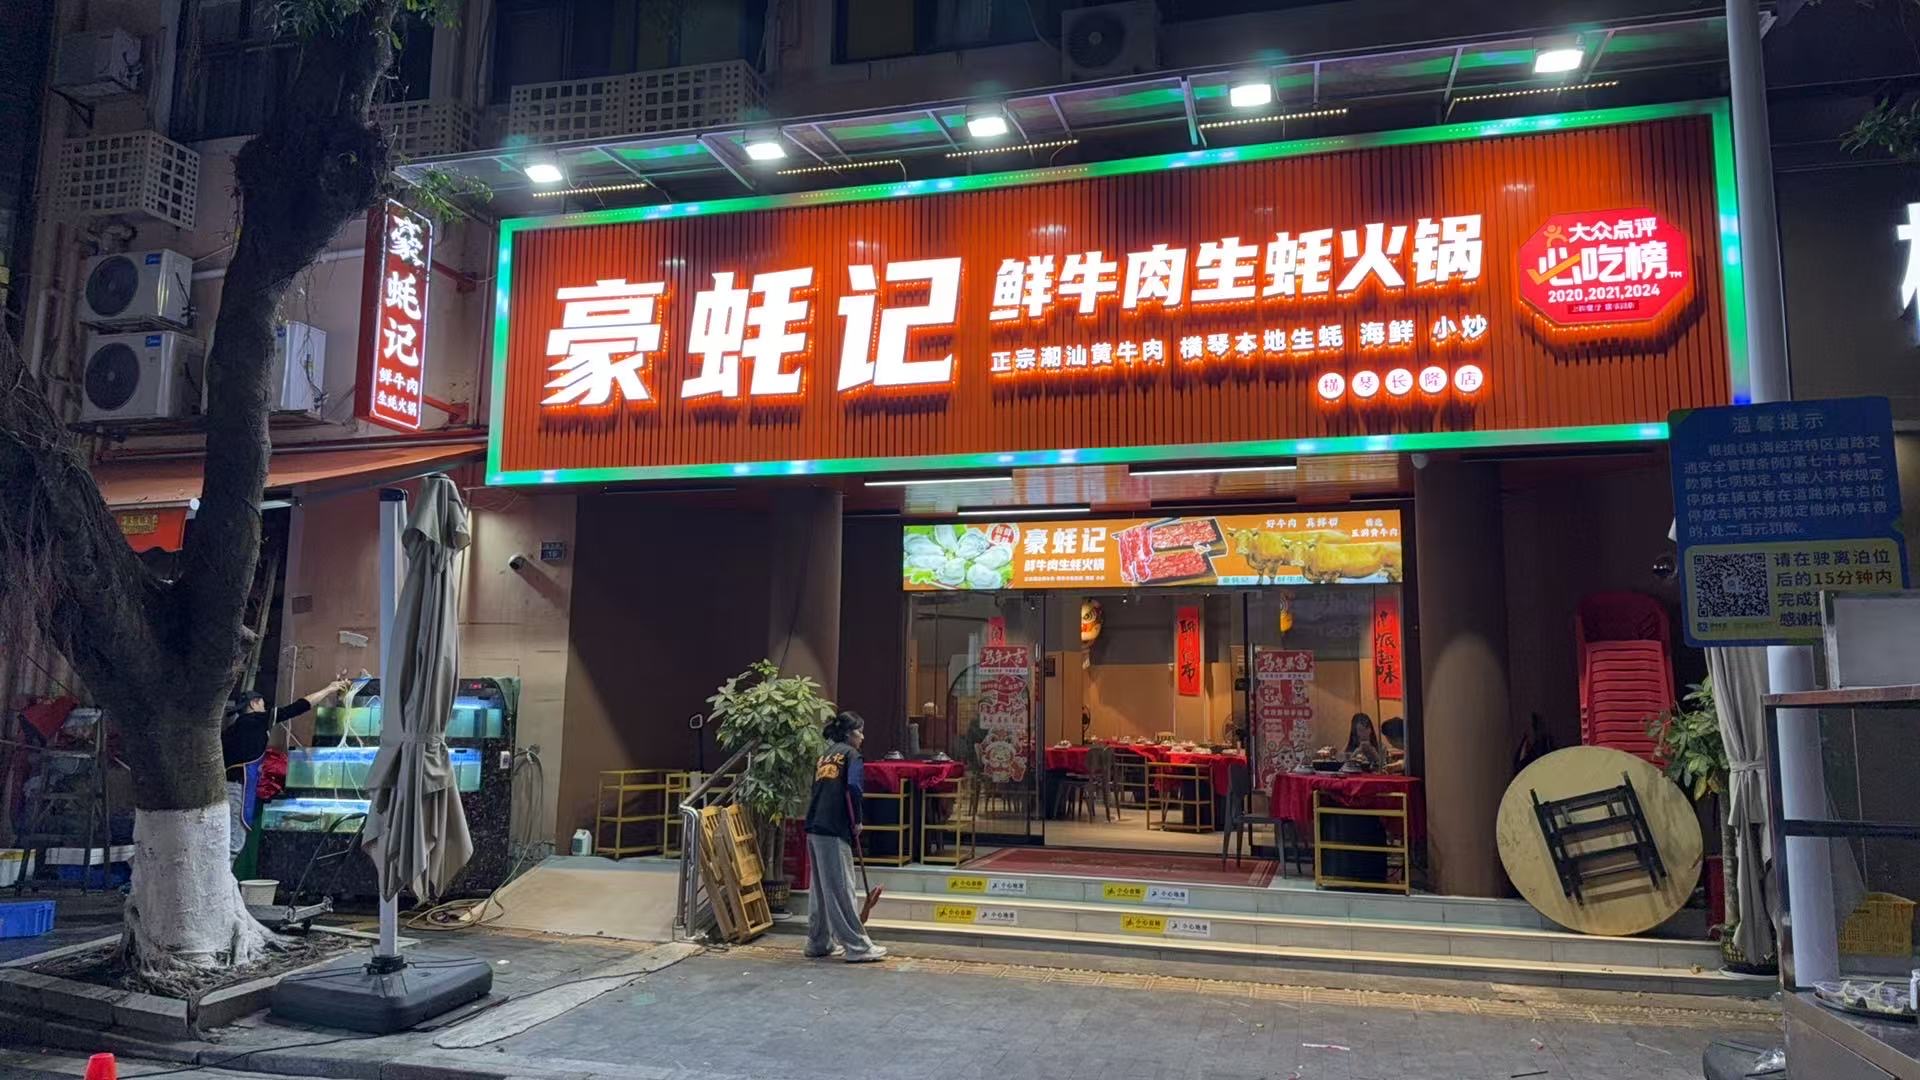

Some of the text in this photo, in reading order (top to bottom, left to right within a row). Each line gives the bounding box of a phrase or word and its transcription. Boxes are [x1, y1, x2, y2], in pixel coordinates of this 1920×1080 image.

[1568, 217, 1657, 243] 大众点评
[988, 214, 1483, 320] 鲜牛肉生蚝火锅
[1530, 241, 1668, 287] 必吃榜
[384, 216, 425, 367] 豪蚝记
[541, 257, 962, 405] 豪蚝记
[990, 315, 1487, 372] 正宗潮汕黄牛肉 横琴本地生蚝 海鲜 小炒
[1322, 369, 1477, 394] 横琴长隆店
[1732, 412, 1824, 433] 温馨提示
[1024, 527, 1106, 554] 豪蚝记
[1773, 549, 1891, 568] 请在驶离泊位
[1776, 569, 1892, 587] 后的15分钟内
